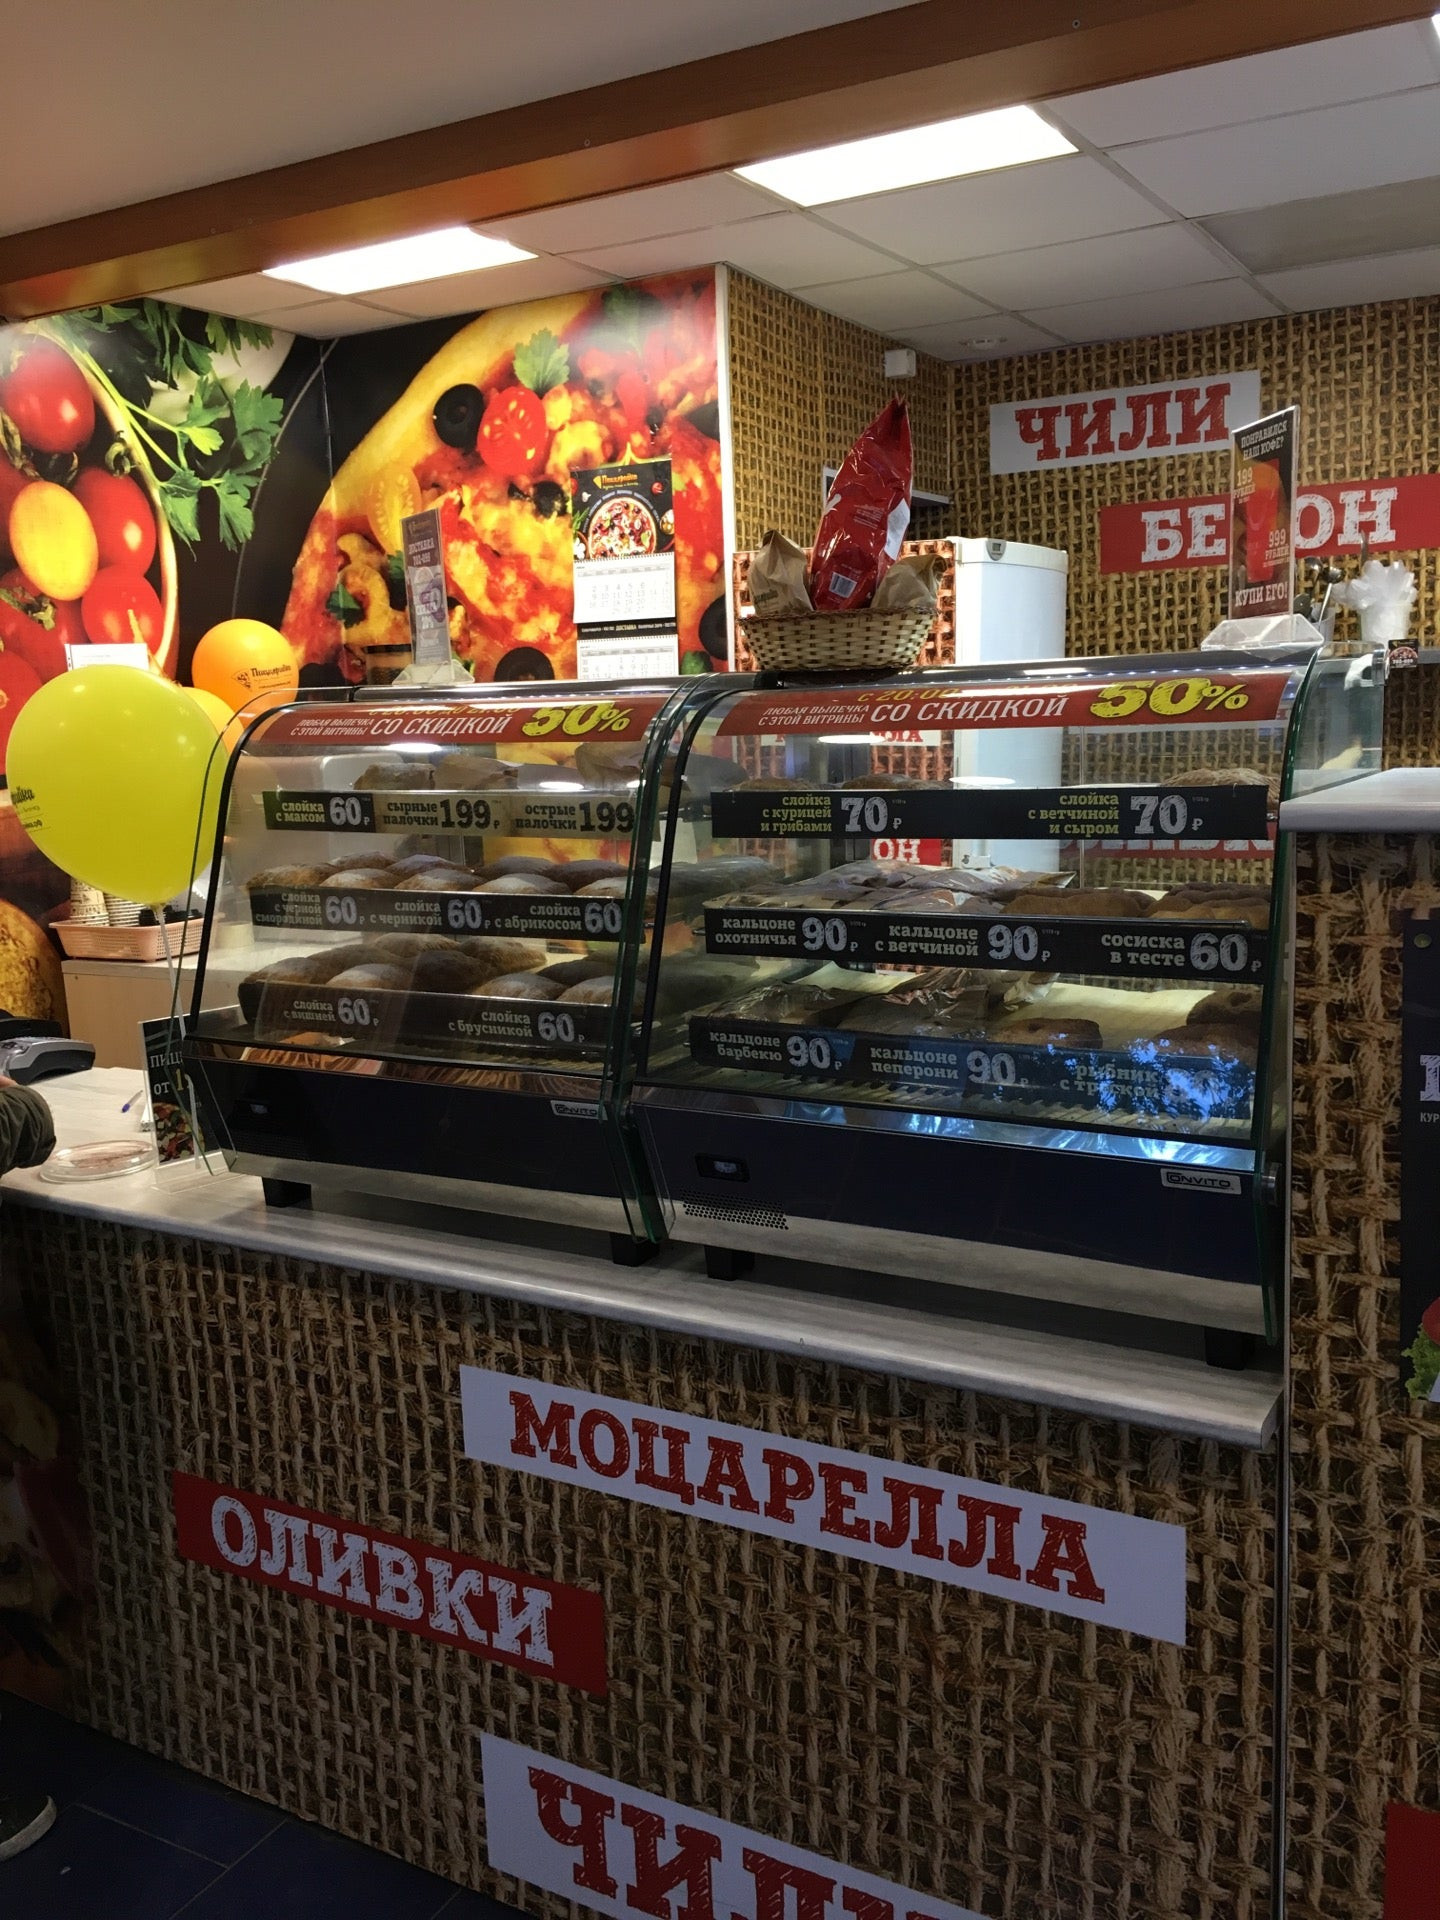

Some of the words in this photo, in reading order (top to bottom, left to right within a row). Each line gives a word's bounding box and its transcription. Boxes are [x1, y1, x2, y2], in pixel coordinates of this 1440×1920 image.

[1015, 382, 1231, 461] ЧИЛИ
[1241, 420, 1287, 449] ПОНРАВИЛСЯ
[1243, 444, 1260, 461] НАШ
[1237, 467, 1253, 487] 199
[1141, 487, 1398, 563] БЕОН
[1268, 528, 1286, 548] 999
[1265, 543, 1290, 561] РУБЛЕЙ
[1235, 585, 1264, 607] КУПИ
[1265, 581, 1288, 602] ЕГО!
[1089, 677, 1249, 718] 50%
[765, 706, 807, 716] ЛЮБАЯ
[810, 704, 871, 715] ВЫПЕЧКА
[870, 703, 912, 722] СО
[917, 695, 1069, 722] СКИДКОЙ
[297, 718, 331, 728] ЛЮБАЯ
[330, 718, 373, 728] ВЫПЕЧКА
[371, 718, 403, 735] СО
[403, 713, 512, 737] СКИДКОЙ
[759, 717, 769, 726] С
[771, 714, 801, 726] ЭТОЙ
[802, 714, 865, 725] ВИТРИНЫ
[281, 800, 325, 814] слойка
[782, 795, 832, 807] слойка
[1060, 792, 1119, 807] слойка
[276, 812, 284, 822] с
[285, 813, 327, 823] маком
[330, 796, 362, 826] 60
[387, 802, 438, 817] сырные
[441, 798, 491, 830] 199
[524, 804, 576, 819] острые
[580, 801, 635, 833] 199
[763, 810, 771, 819] с
[772, 807, 832, 823] курицей
[841, 797, 888, 833] 70
[1028, 811, 1037, 820] с
[1039, 807, 1119, 821] ветчиной
[1130, 794, 1188, 835] 70
[384, 815, 439, 827] палочки
[514, 818, 577, 831] палочки
[761, 823, 773, 833] и
[777, 820, 832, 838] грибами
[1049, 825, 1060, 834] и
[1064, 824, 1119, 838] сыром
[281, 891, 322, 904] слойка
[394, 898, 442, 914] слойка
[325, 895, 358, 926] 60
[447, 899, 482, 930] 60
[530, 902, 582, 917] слойка
[585, 902, 622, 935] 60
[369, 914, 378, 925] с
[379, 912, 444, 929] черникой
[494, 919, 503, 929] с
[504, 915, 584, 934] абрикосом
[723, 917, 796, 934] кальцоне
[715, 933, 797, 946] охотничья
[802, 916, 848, 952] 90
[888, 924, 979, 941] кальцоне
[1101, 932, 1185, 950] сосиска
[874, 939, 884, 951] с
[887, 938, 979, 957] ветчиной
[988, 924, 1039, 962] 90
[1190, 932, 1249, 972] 60
[1109, 950, 1122, 965] в
[1127, 951, 1186, 967] тесте
[292, 998, 334, 1012] слойка
[338, 996, 370, 1026] 60
[291, 1009, 337, 1022] вишней
[481, 1009, 531, 1025] слойка
[448, 1021, 458, 1032] с
[458, 1019, 534, 1039] брусникой
[537, 1011, 575, 1043] 60
[709, 1030, 781, 1048] кальцоне
[716, 1044, 783, 1063] барбекю
[786, 1035, 832, 1070] 90
[870, 1046, 958, 1066] кальцоне
[871, 1060, 959, 1080] пеперони
[965, 1049, 1017, 1086] 90
[509, 1390, 1106, 1604] МОЦАРЕЛЛА
[211, 1495, 555, 1668] ОЛИВКИ
[528, 1766, 928, 1920] ЧИЛ
